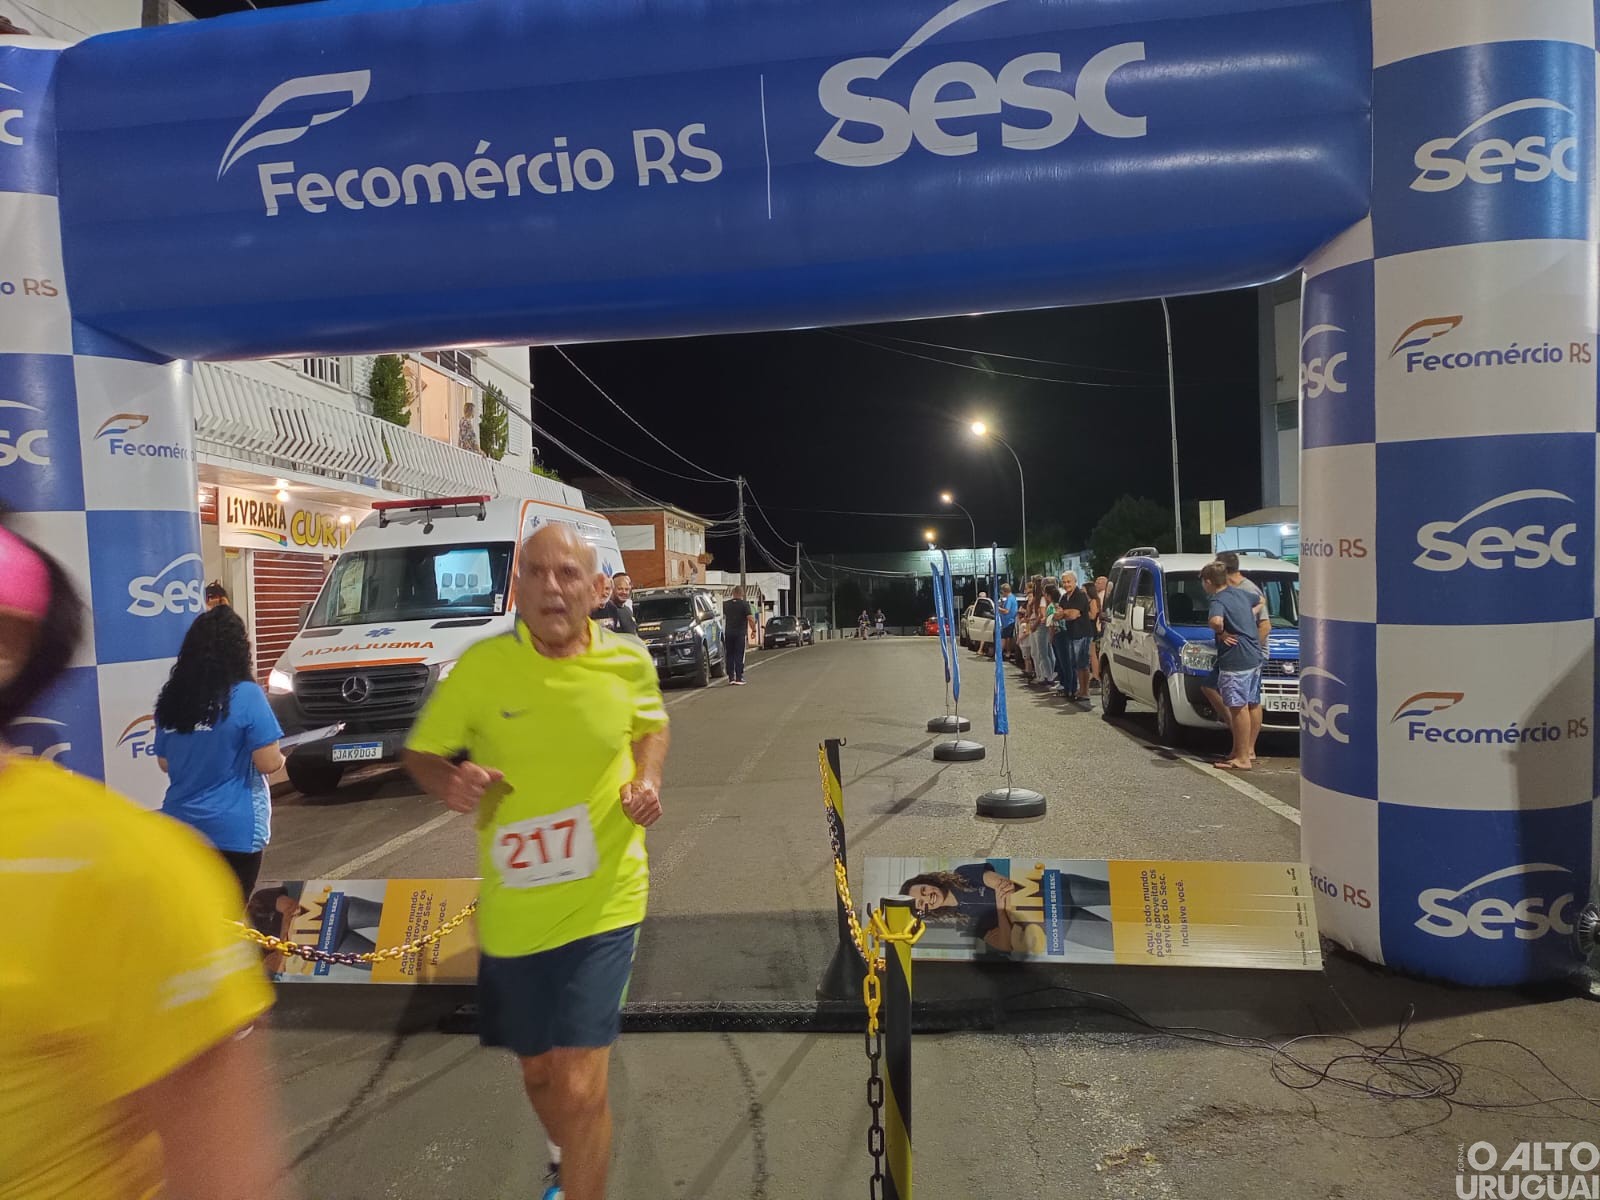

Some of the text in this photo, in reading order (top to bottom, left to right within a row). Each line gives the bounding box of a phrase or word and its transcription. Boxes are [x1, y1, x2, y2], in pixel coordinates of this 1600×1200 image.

[814, 41, 1147, 167] Sesc
[257, 123, 723, 217] Fecomércio RS
[1409, 136, 1577, 192] Sesc
[23, 278, 58, 297] RS
[1407, 342, 1592, 372] Fecomércio RS
[1339, 539, 1368, 558] RS
[1412, 521, 1577, 571] Sesc
[127, 576, 207, 617] Ses
[1408, 718, 1588, 744] Fecomércio RS
[501, 818, 576, 869] 217
[1140, 870, 1150, 901] mundo
[1343, 884, 1371, 909] RS
[409, 891, 419, 923] mundo
[1143, 904, 1152, 926] todo
[1150, 869, 1164, 957] pode aproveitar os
[1161, 898, 1168, 911] do
[1414, 887, 1574, 940] Sesc
